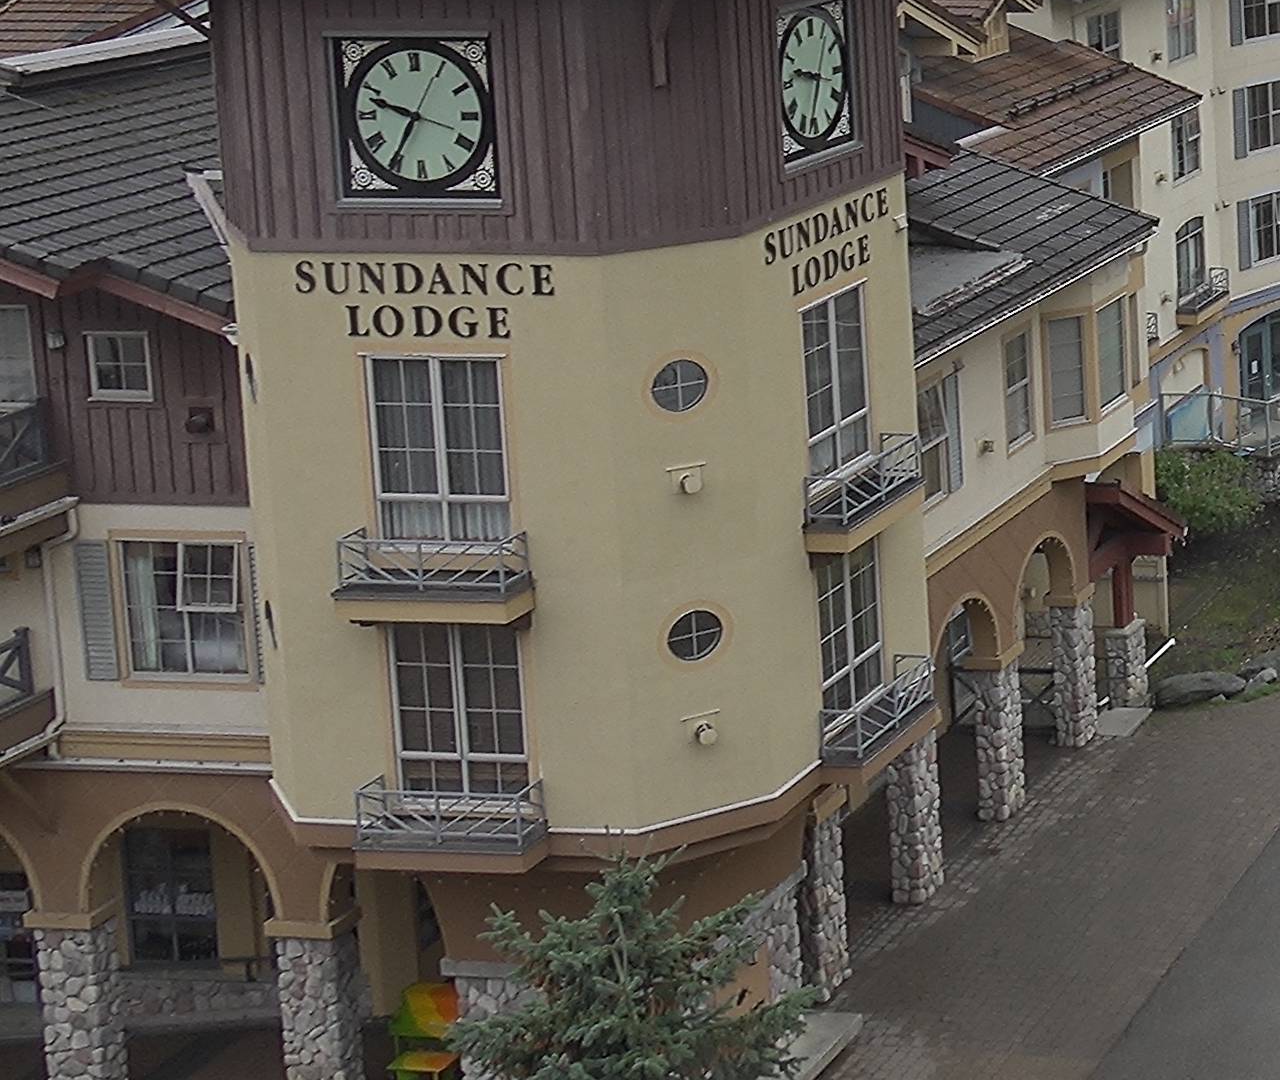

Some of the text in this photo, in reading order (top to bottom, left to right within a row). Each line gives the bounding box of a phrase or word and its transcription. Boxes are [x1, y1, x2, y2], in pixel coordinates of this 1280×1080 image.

[764, 187, 889, 266] SUNDANCE
[295, 260, 555, 296] SUNDANCE
[792, 234, 871, 297] LODGE
[345, 304, 511, 339] LODGE
